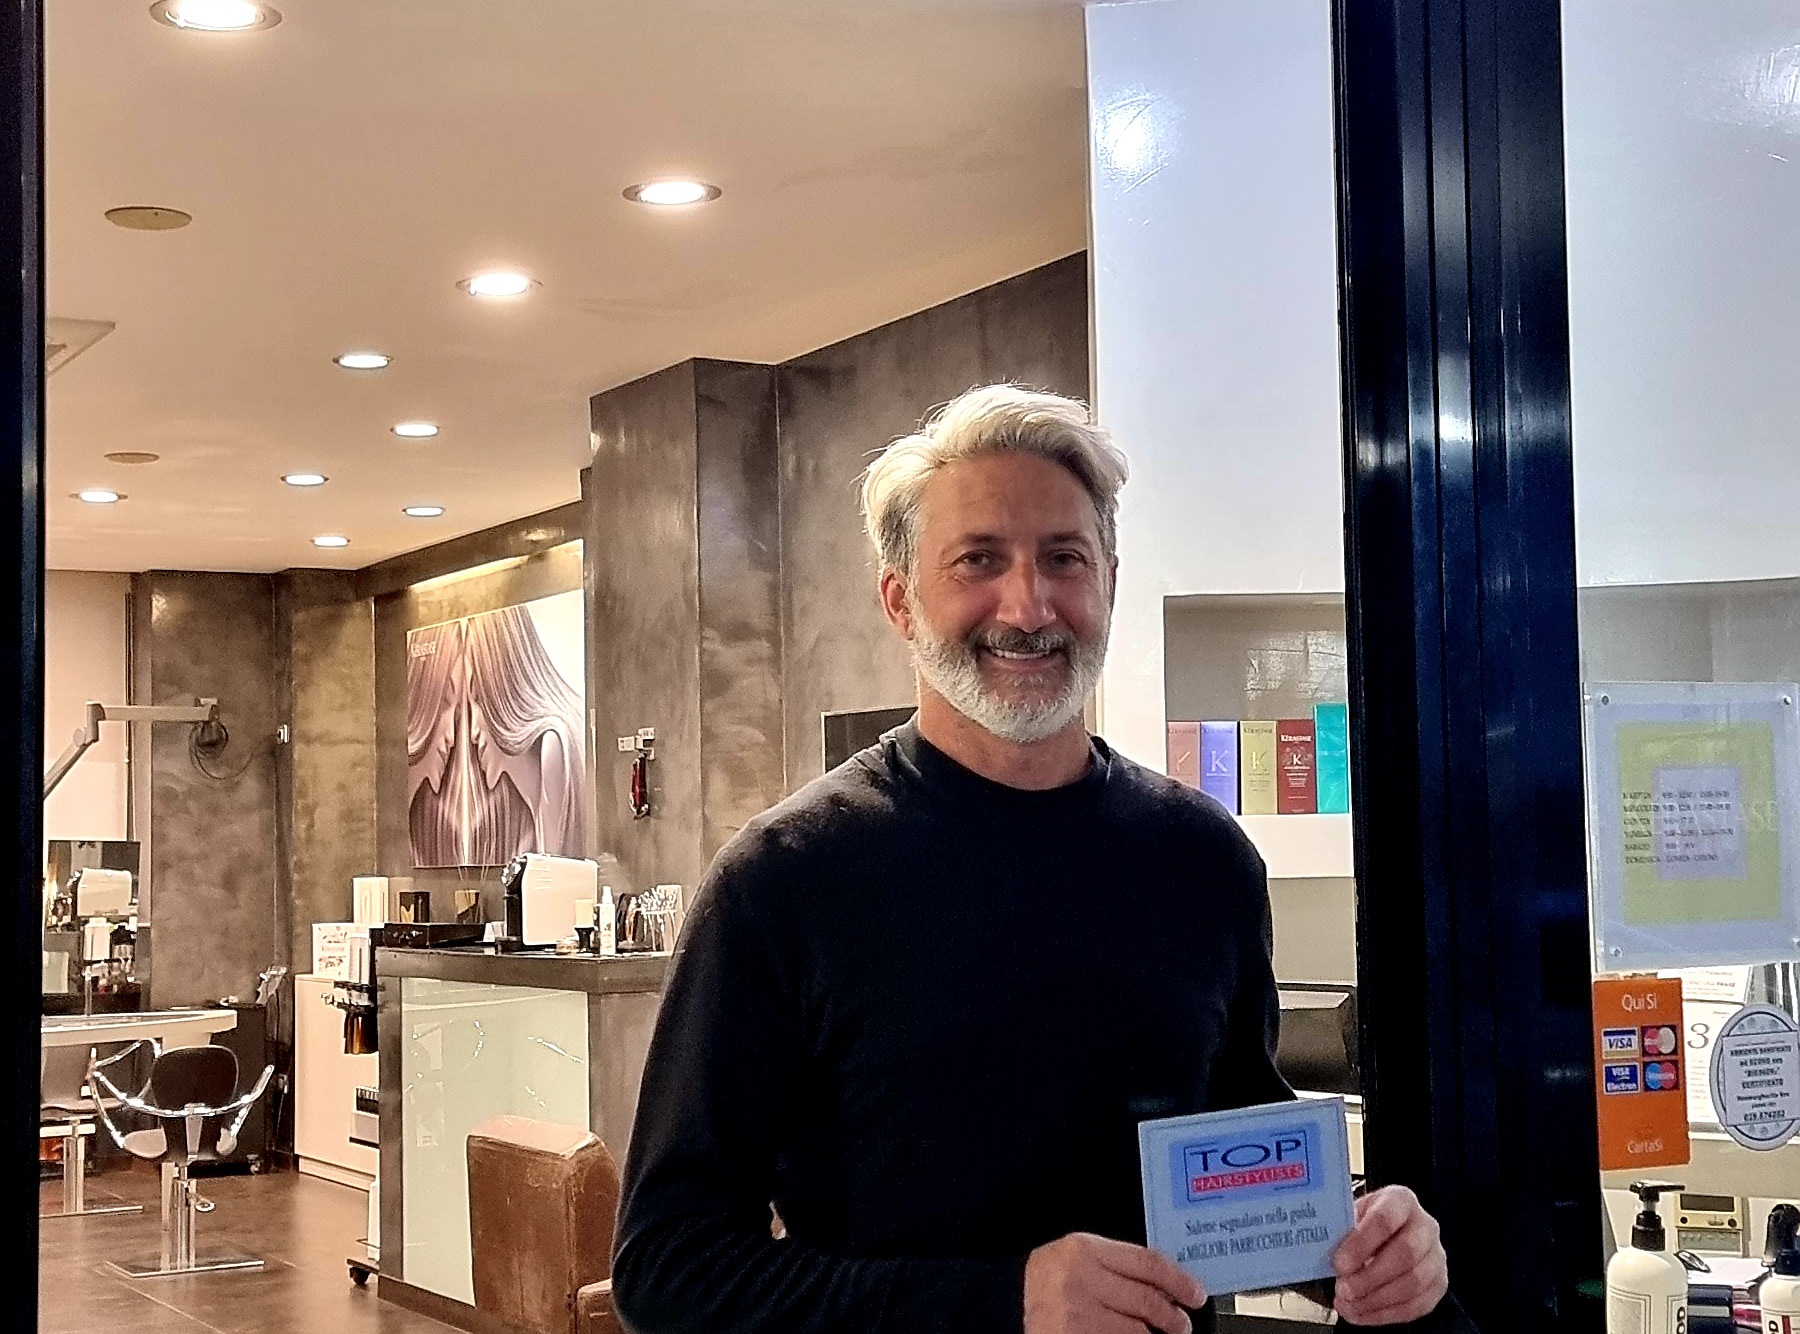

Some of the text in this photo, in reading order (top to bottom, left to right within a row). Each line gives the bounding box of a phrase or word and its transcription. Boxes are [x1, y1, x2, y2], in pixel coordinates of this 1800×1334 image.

[1211, 750, 1228, 772] K
[1293, 754, 1302, 765] K
[1621, 994, 1645, 1012] Qui
[1608, 1037, 1633, 1049] VISA
[1687, 1023, 1710, 1049] 3
[1189, 1139, 1302, 1171] TOP
